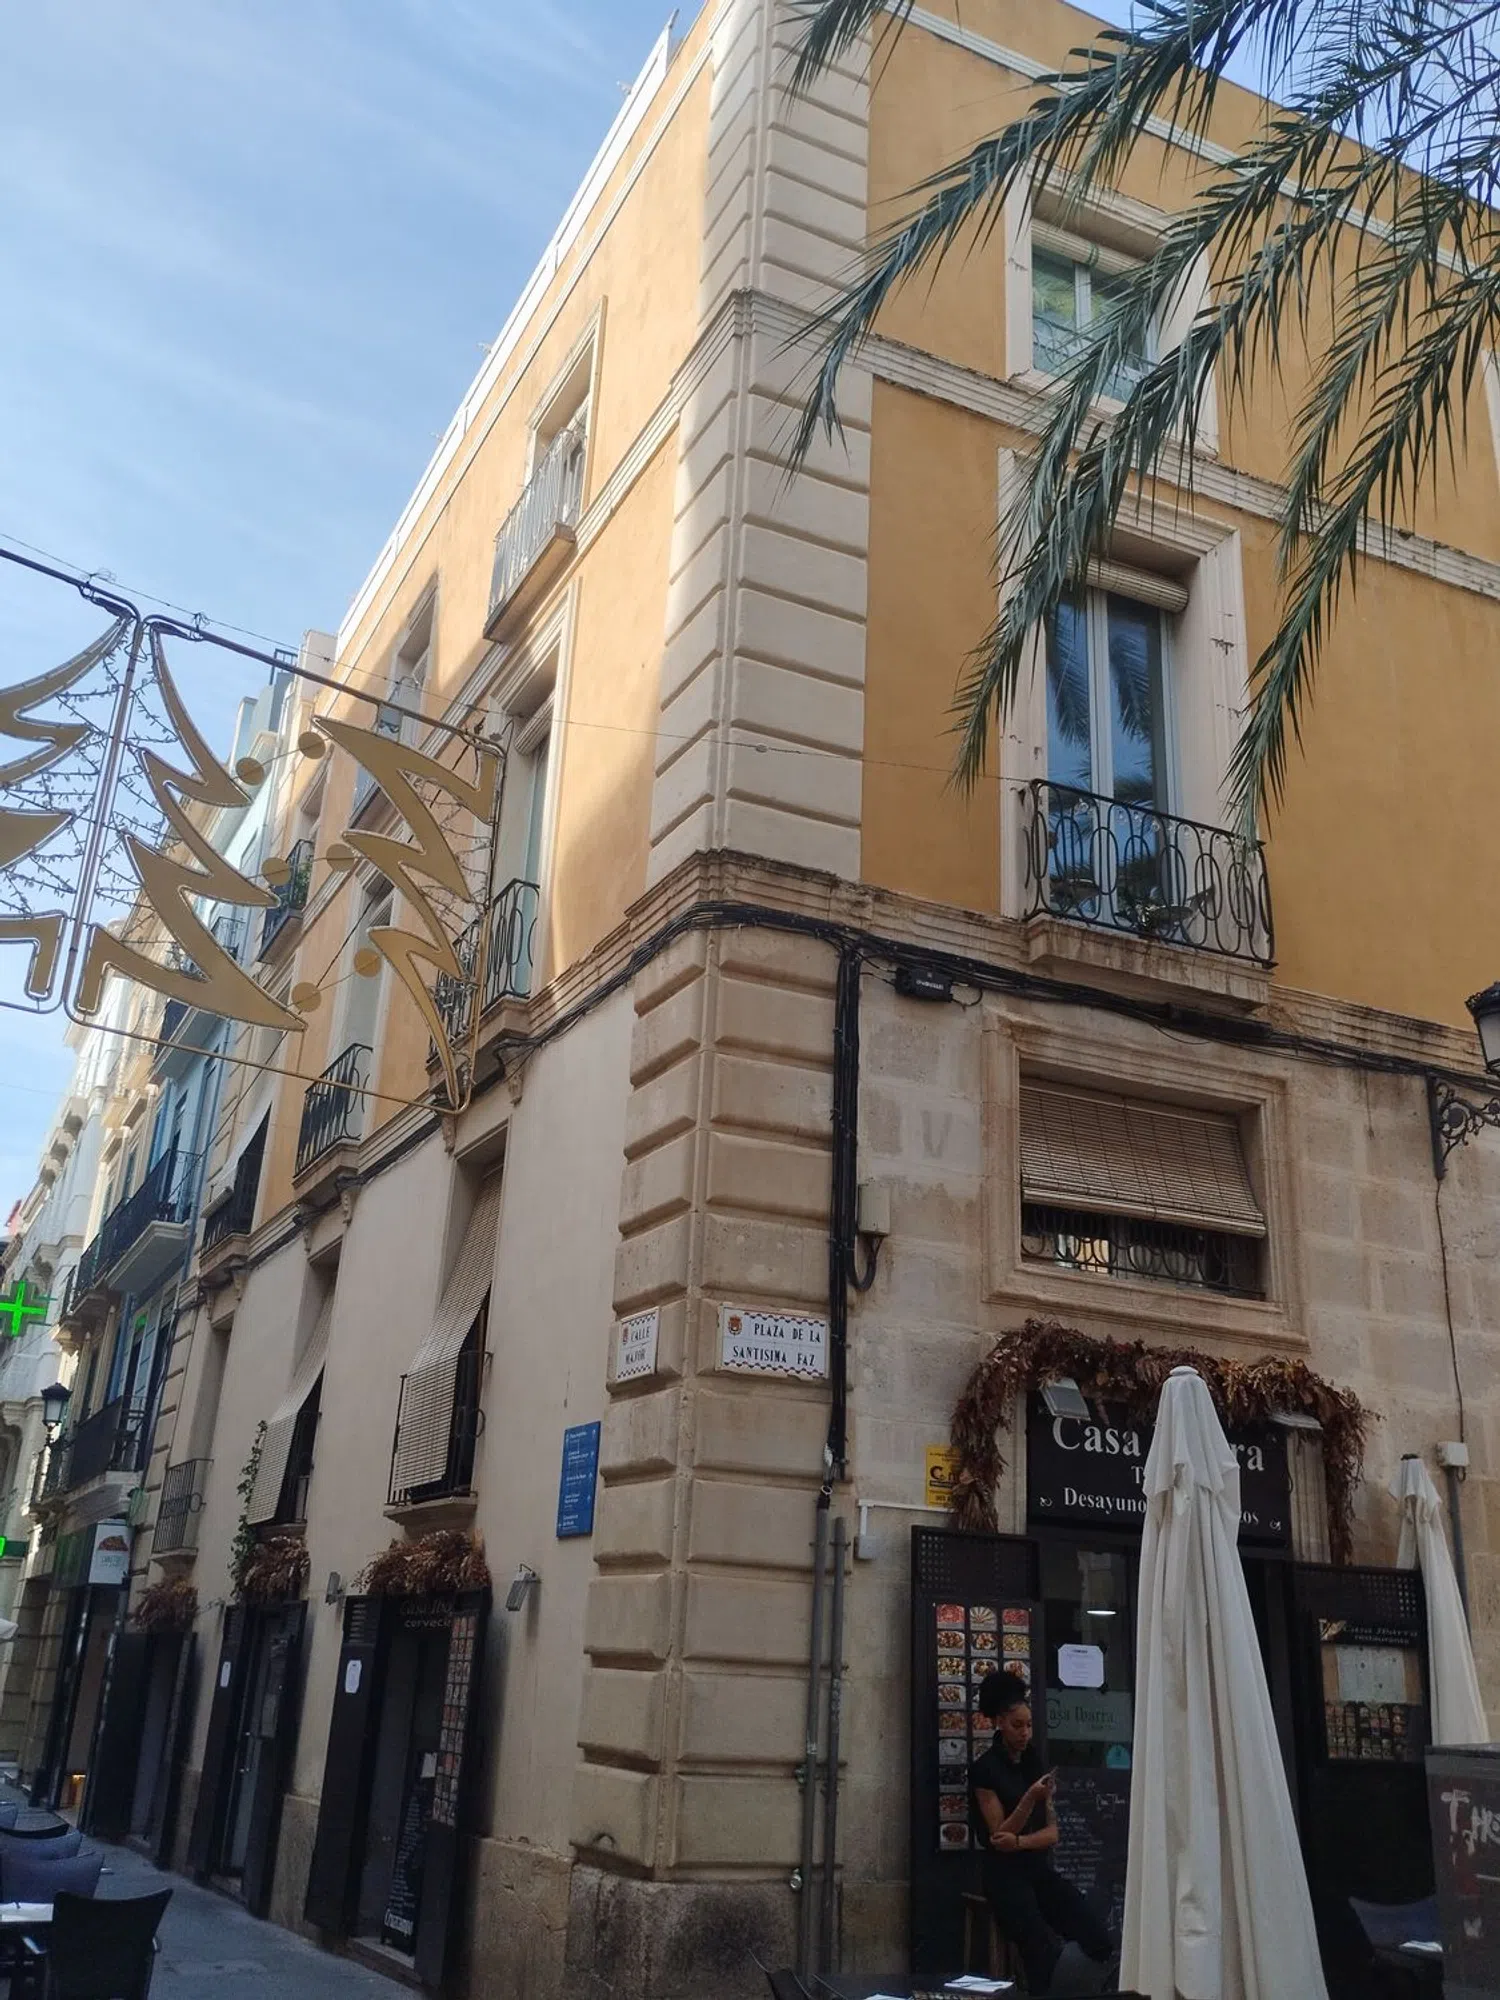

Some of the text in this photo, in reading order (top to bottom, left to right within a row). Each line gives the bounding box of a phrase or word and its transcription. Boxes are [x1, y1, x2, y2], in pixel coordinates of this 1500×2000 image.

[631, 1326, 652, 1343] CALLE
[754, 1323, 821, 1343] PLAZA DE LA
[733, 1345, 815, 1367] SANTISIMA FAZ
[1053, 1417, 1141, 1457] Casa
[1064, 1487, 1147, 1515] Desayuno
